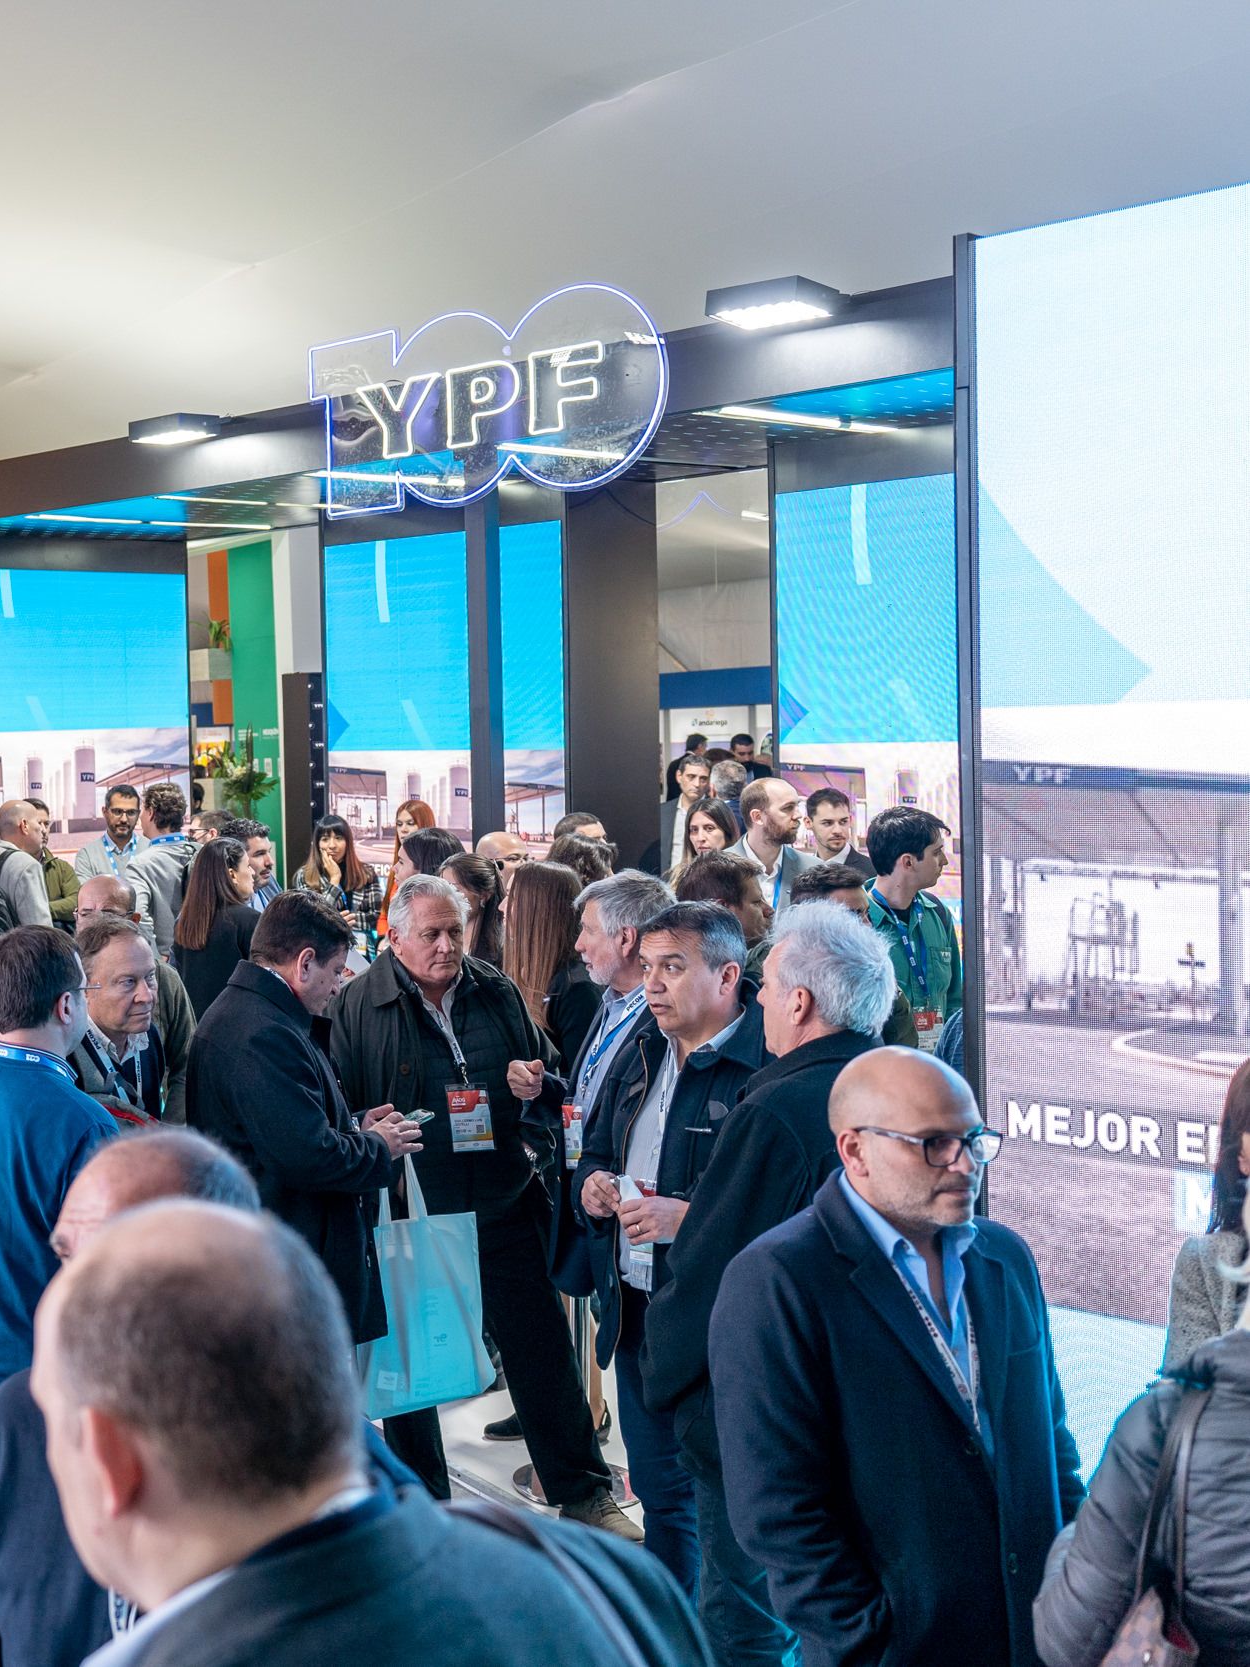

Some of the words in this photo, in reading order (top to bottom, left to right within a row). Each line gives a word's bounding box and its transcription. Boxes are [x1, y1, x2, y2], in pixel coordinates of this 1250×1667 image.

[356, 340, 604, 460] YPF
[1013, 764, 1071, 784] YPF
[626, 993, 644, 1012] PECOM
[1007, 1099, 1161, 1159] MEJOR
